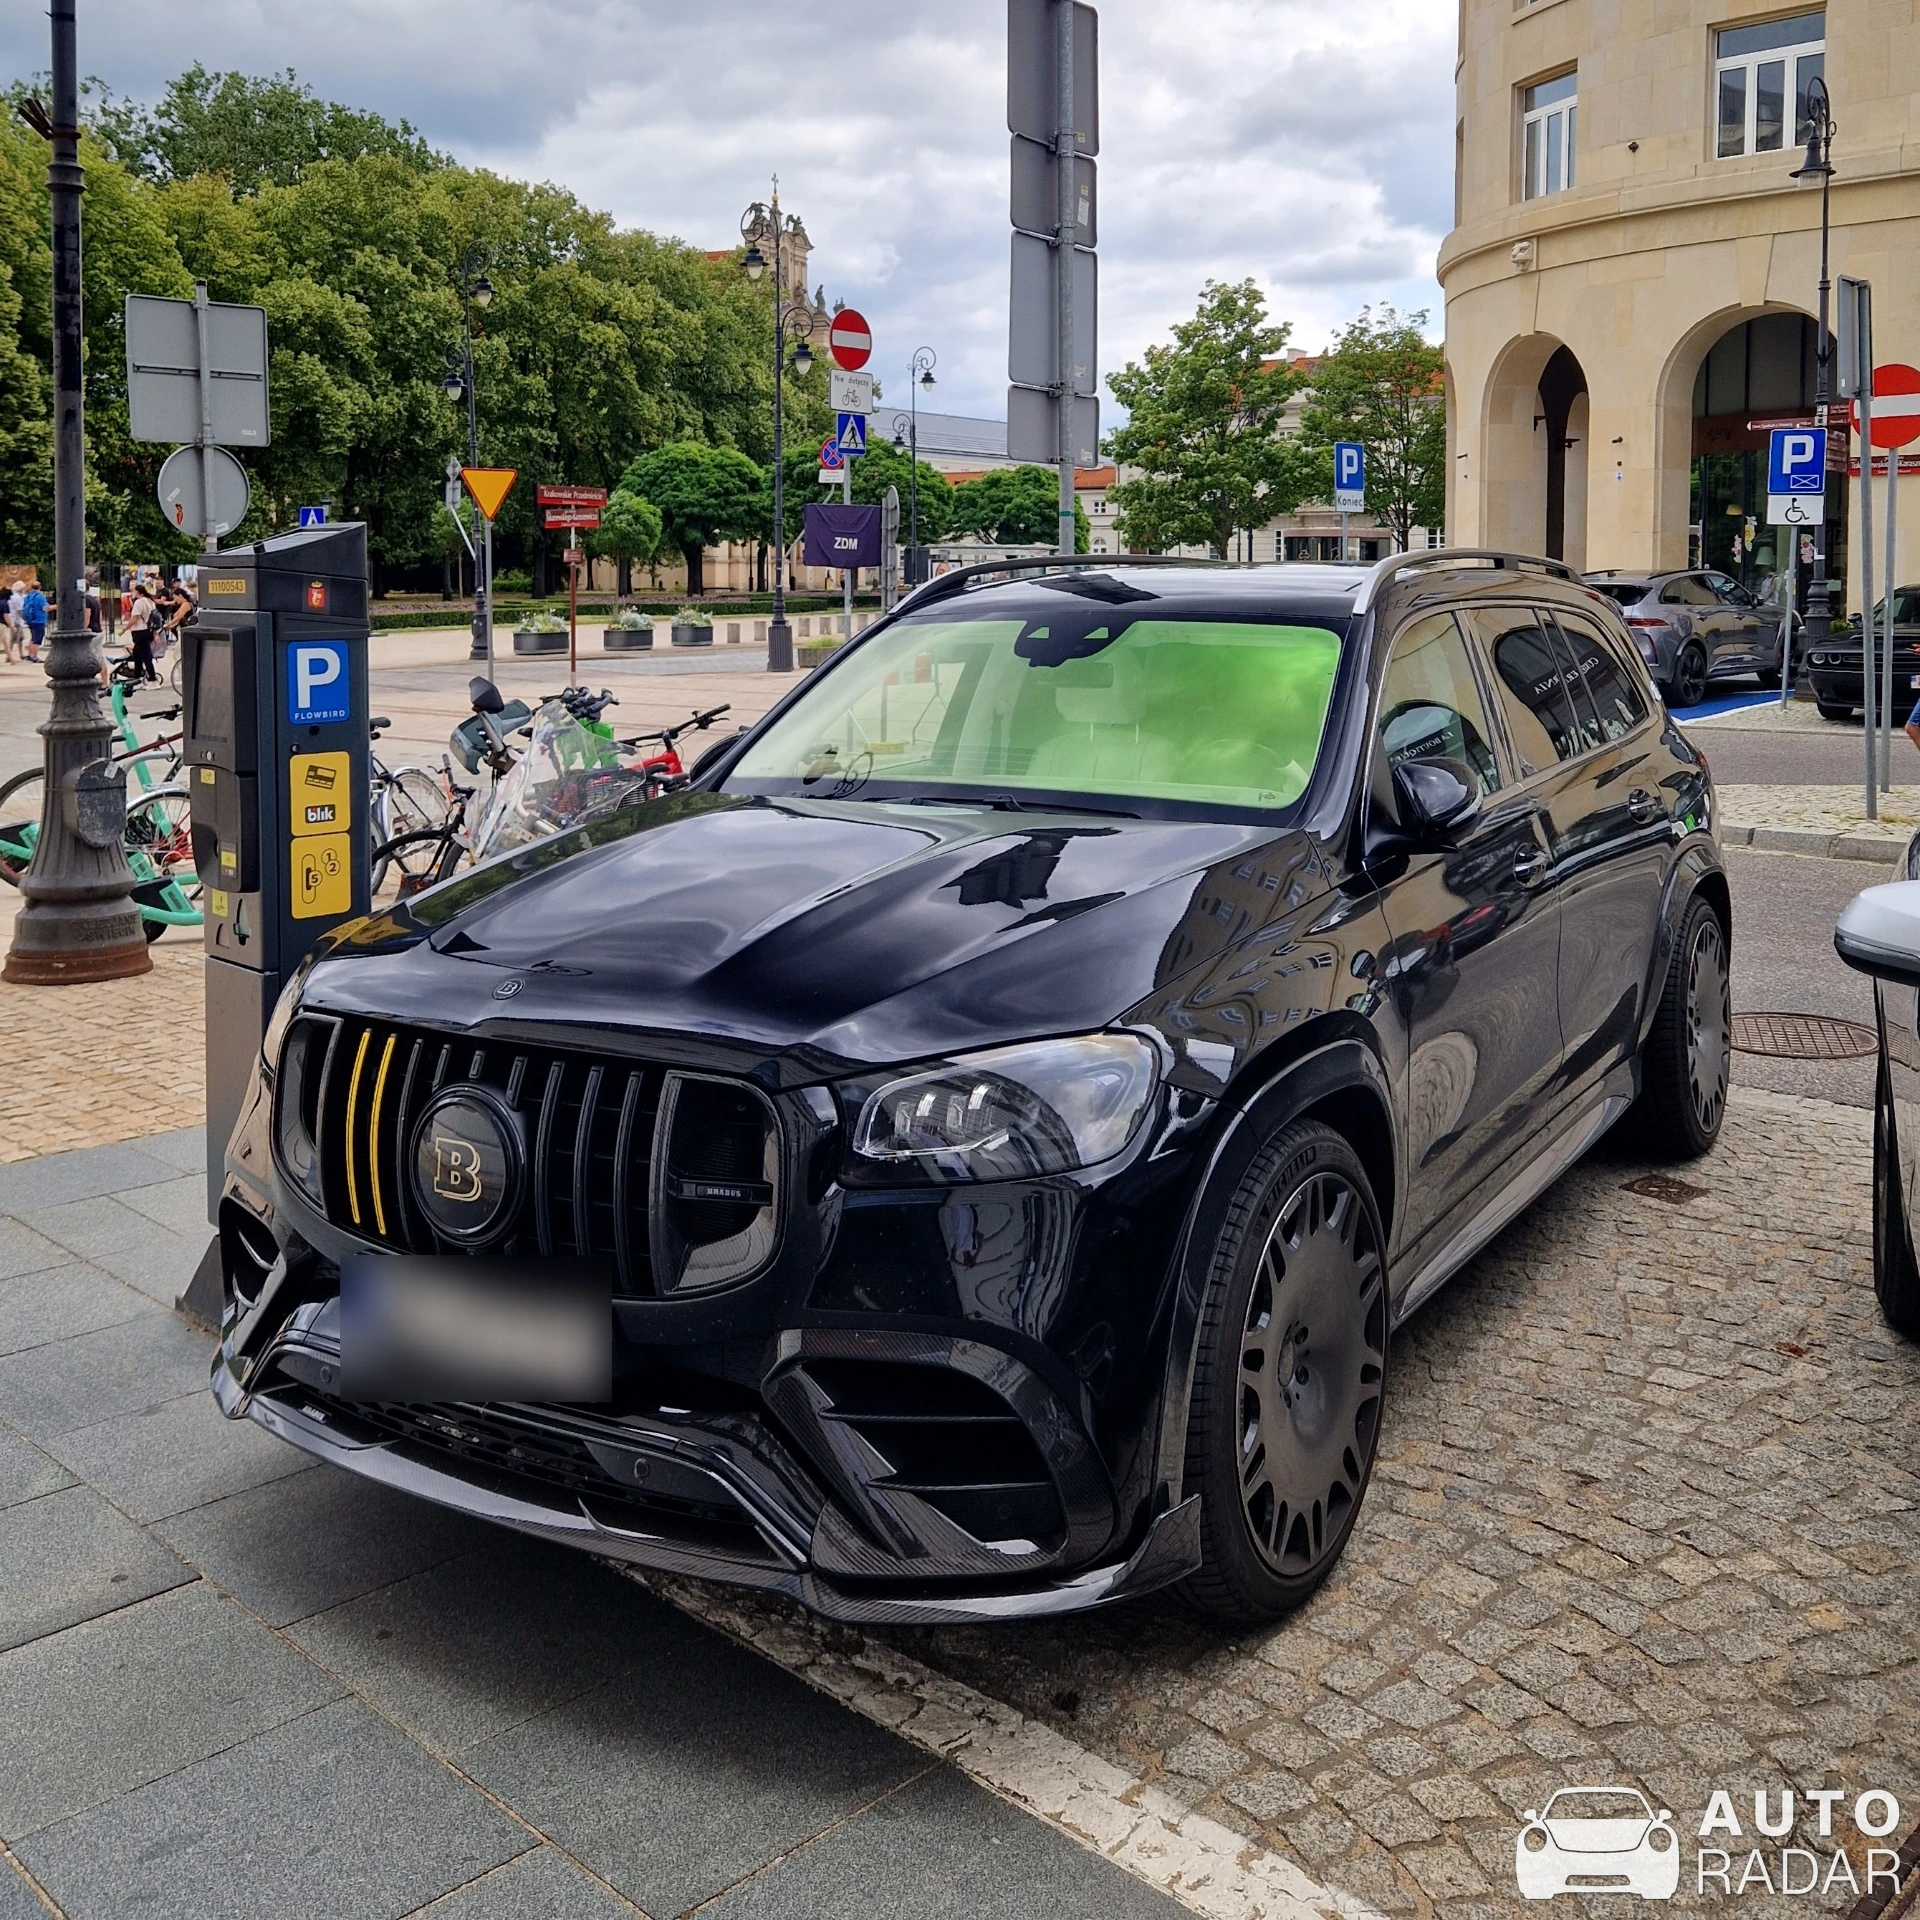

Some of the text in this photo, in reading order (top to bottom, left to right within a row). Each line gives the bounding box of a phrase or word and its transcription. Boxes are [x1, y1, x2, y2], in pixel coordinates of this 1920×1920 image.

[834, 374, 869, 387] Nie dotyczy
[1782, 435, 1815, 474] P
[1342, 448, 1359, 484] P
[1337, 495, 1363, 506] Koniec
[834, 536, 858, 550] ZDM
[210, 581, 244, 592] 11100543
[296, 647, 341, 709] P
[294, 709, 346, 720] FLOWBIRD
[307, 804, 334, 822] blik
[434, 1137, 482, 1201] B
[706, 1187, 742, 1197] BRABUS
